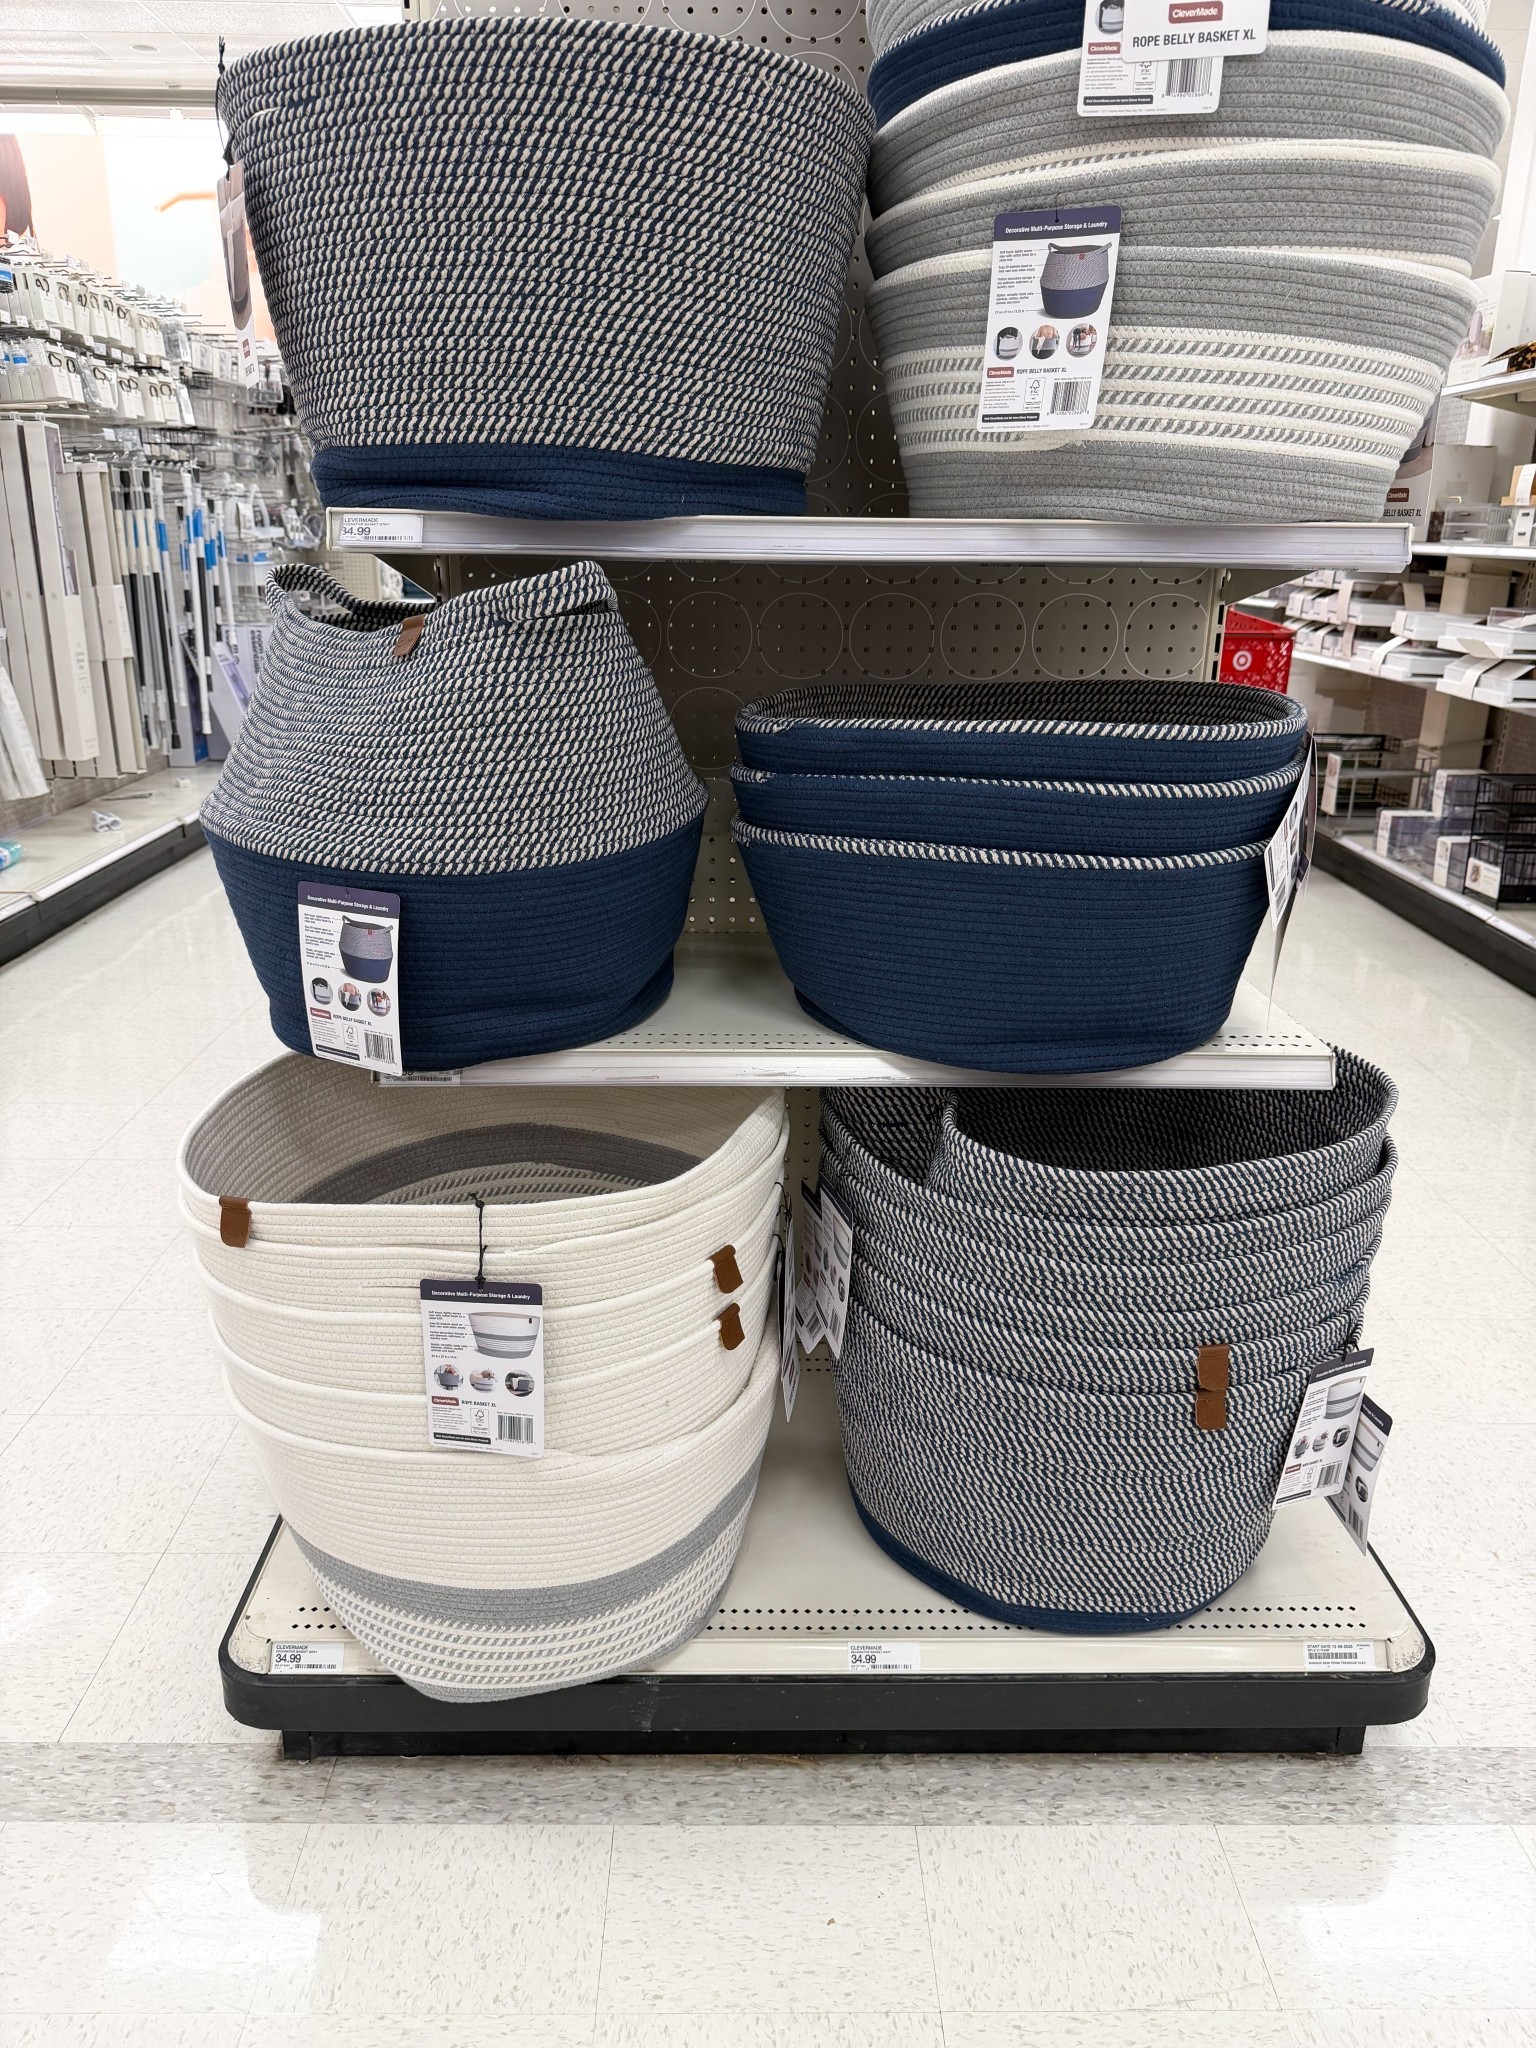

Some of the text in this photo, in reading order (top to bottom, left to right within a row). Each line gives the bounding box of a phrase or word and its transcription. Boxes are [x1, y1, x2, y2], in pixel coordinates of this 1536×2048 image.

[1172, 8, 1218, 18] CleverMade
[1132, 29, 1256, 48] ROPE BELLY BASKET XL
[1031, 225, 1063, 233] Multi-Purpose
[1397, 509, 1415, 517] BASKET
[342, 527, 371, 535] 34.99
[275, 1654, 301, 1663] 34.99
[851, 1654, 876, 1663] 34.99
